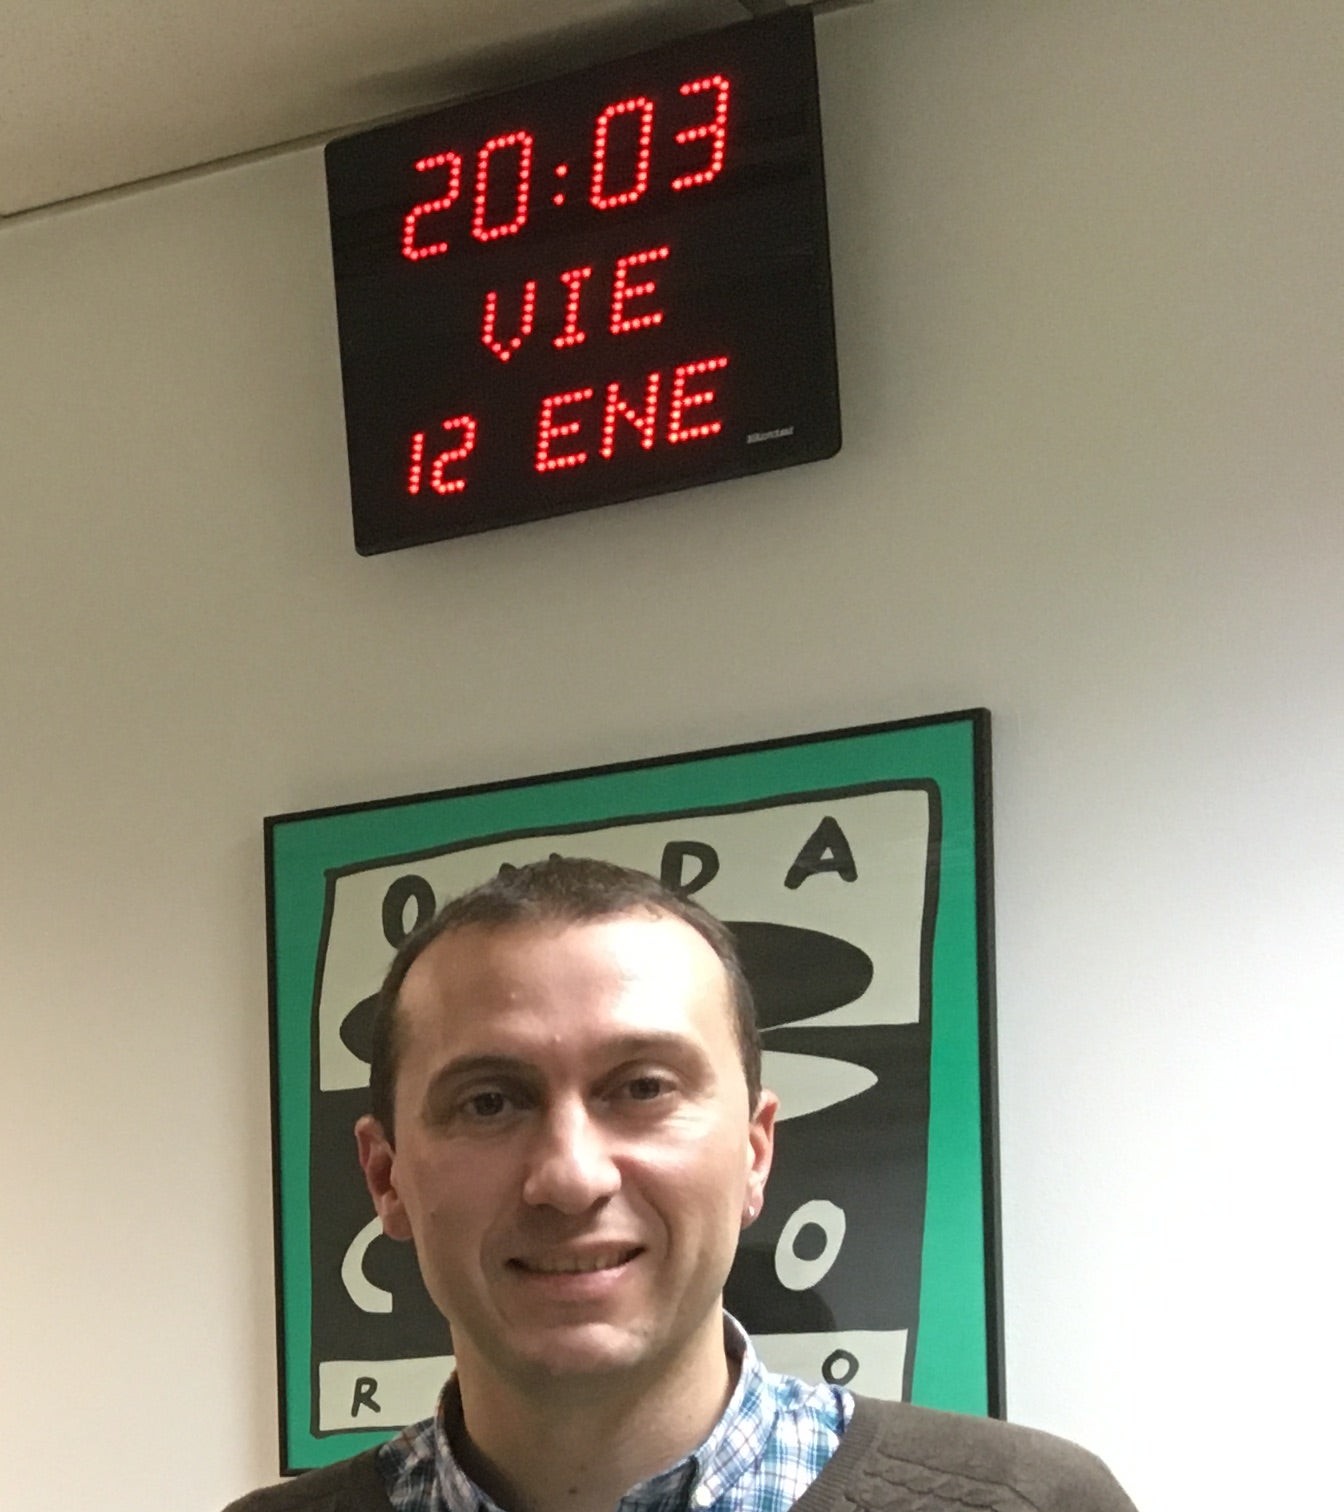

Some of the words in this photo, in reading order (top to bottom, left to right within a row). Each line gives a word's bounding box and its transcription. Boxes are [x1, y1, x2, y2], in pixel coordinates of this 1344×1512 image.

[402, 74, 730, 260] 20:03
[481, 246, 669, 362] VIE
[408, 415, 476, 495] 12
[535, 356, 729, 472] ENE
